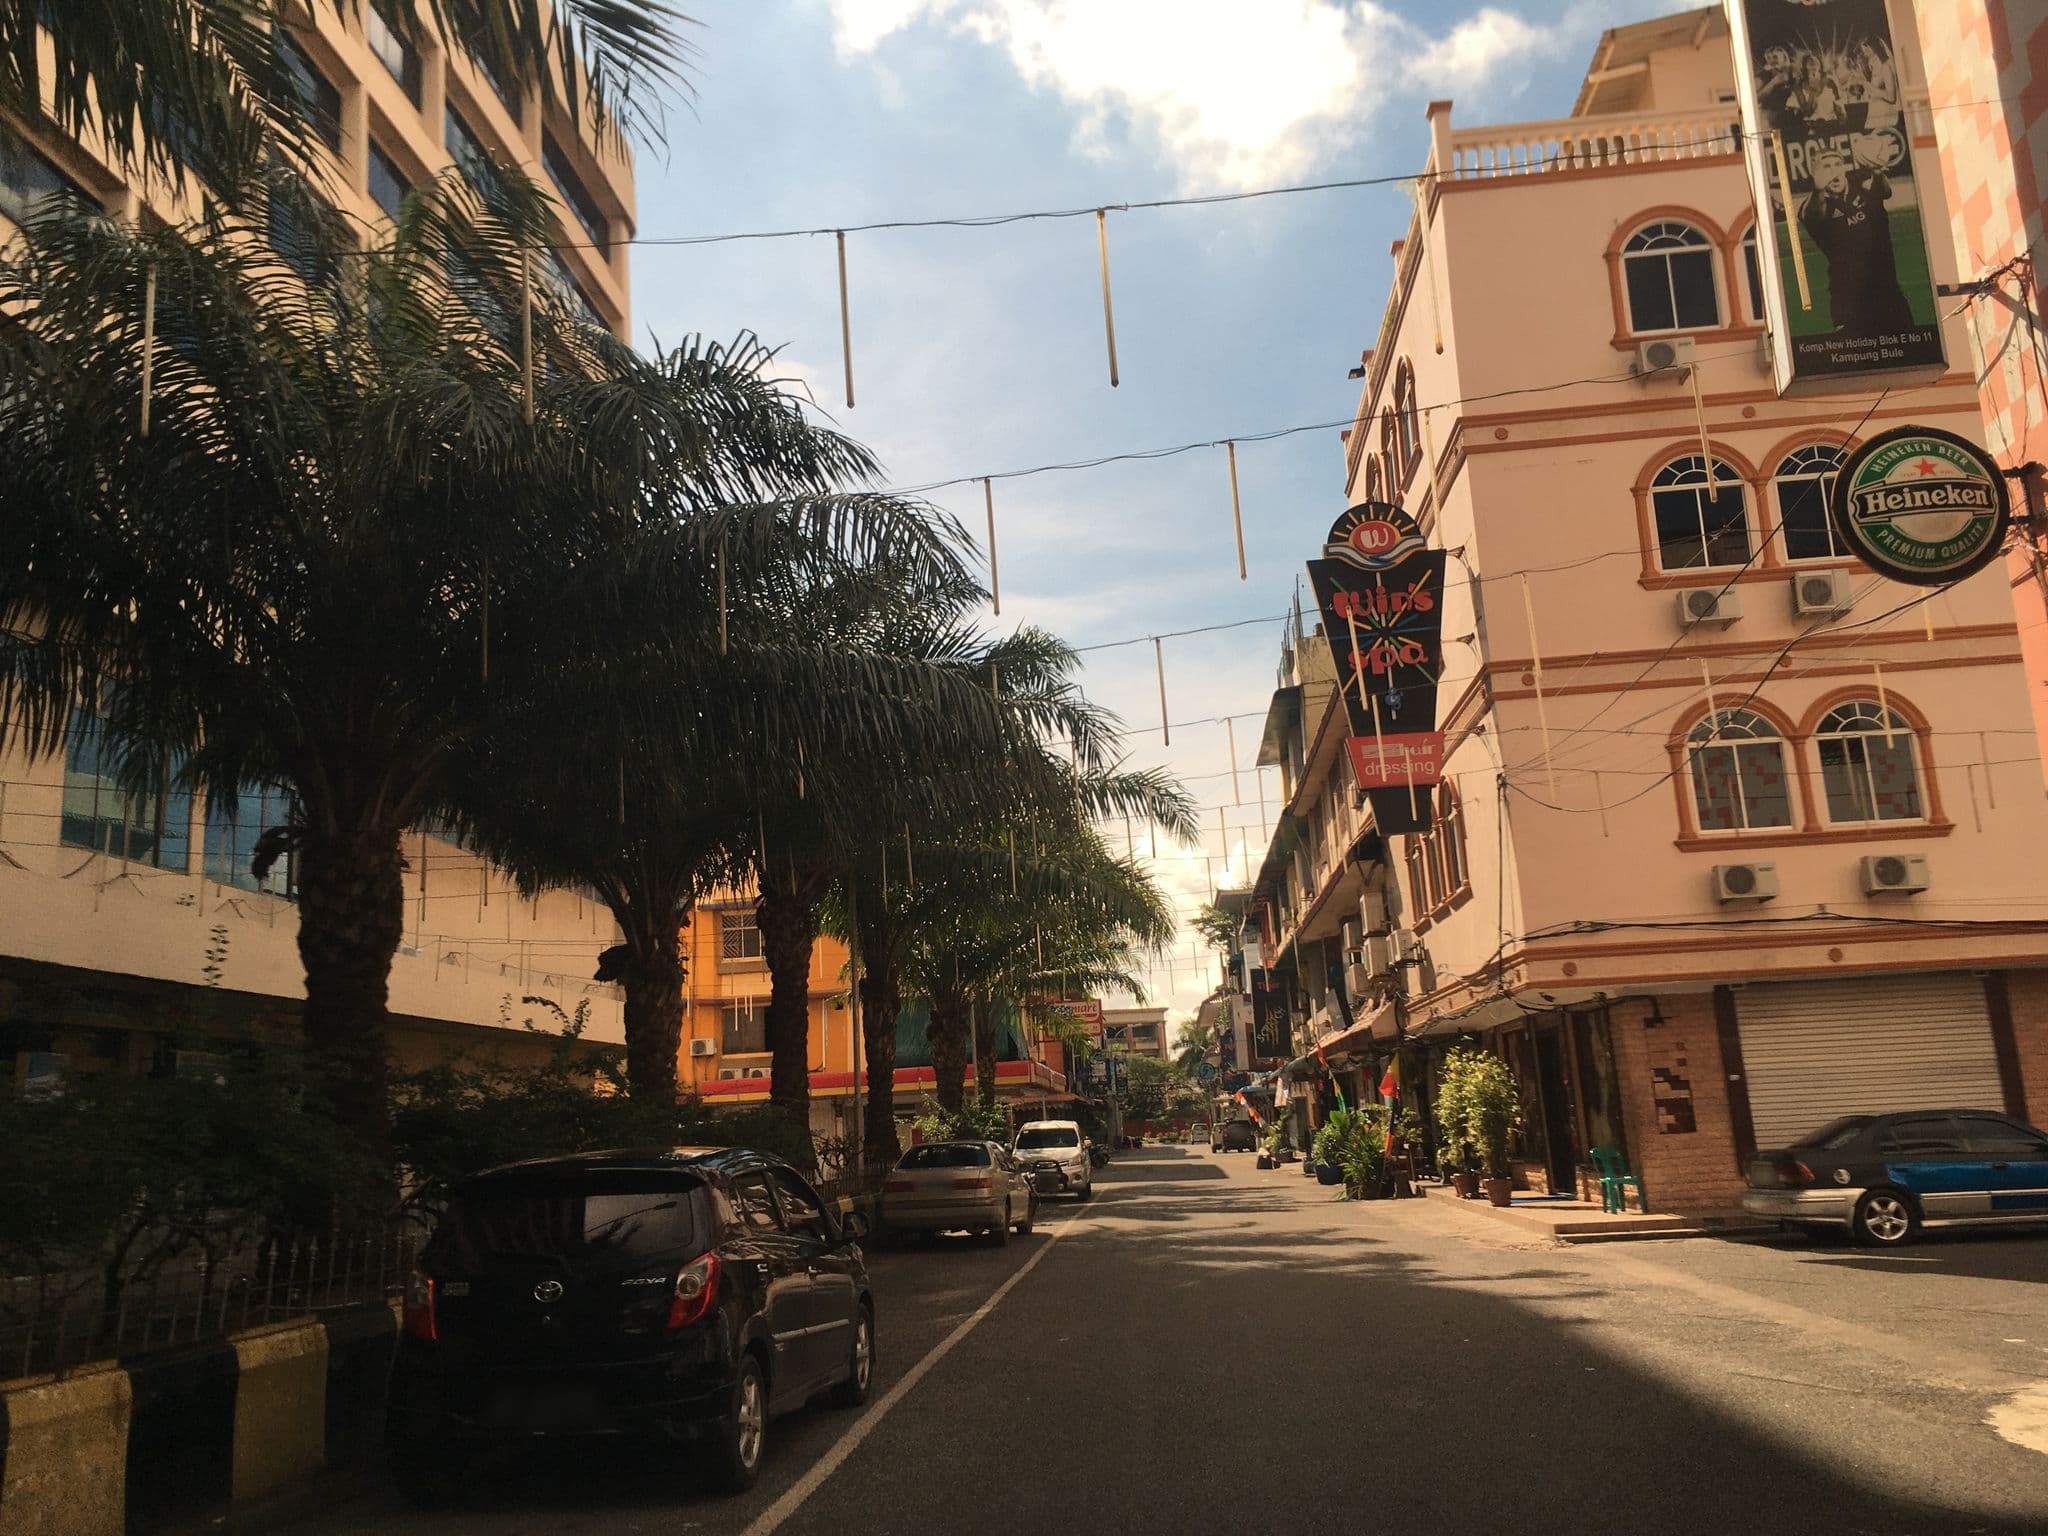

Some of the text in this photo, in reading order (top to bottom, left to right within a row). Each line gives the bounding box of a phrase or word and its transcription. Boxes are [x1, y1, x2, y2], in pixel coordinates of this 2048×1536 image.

[1846, 212, 1866, 227] AIG
[1846, 337, 1878, 349] Holiday
[1879, 335, 1899, 346] Blok
[1901, 334, 1907, 344] E
[1908, 333, 1921, 343] No
[1923, 332, 1933, 342] 11
[1831, 348, 1904, 363] Kampung Bule
[1869, 443, 1969, 473] HEINEKEN BEER
[1864, 484, 1989, 514] Heineken
[1877, 529, 1936, 560] PREMIUM
[1941, 522, 1985, 559] QUALITY
[1347, 645, 1429, 675] spa
[1365, 761, 1435, 775] dressing
